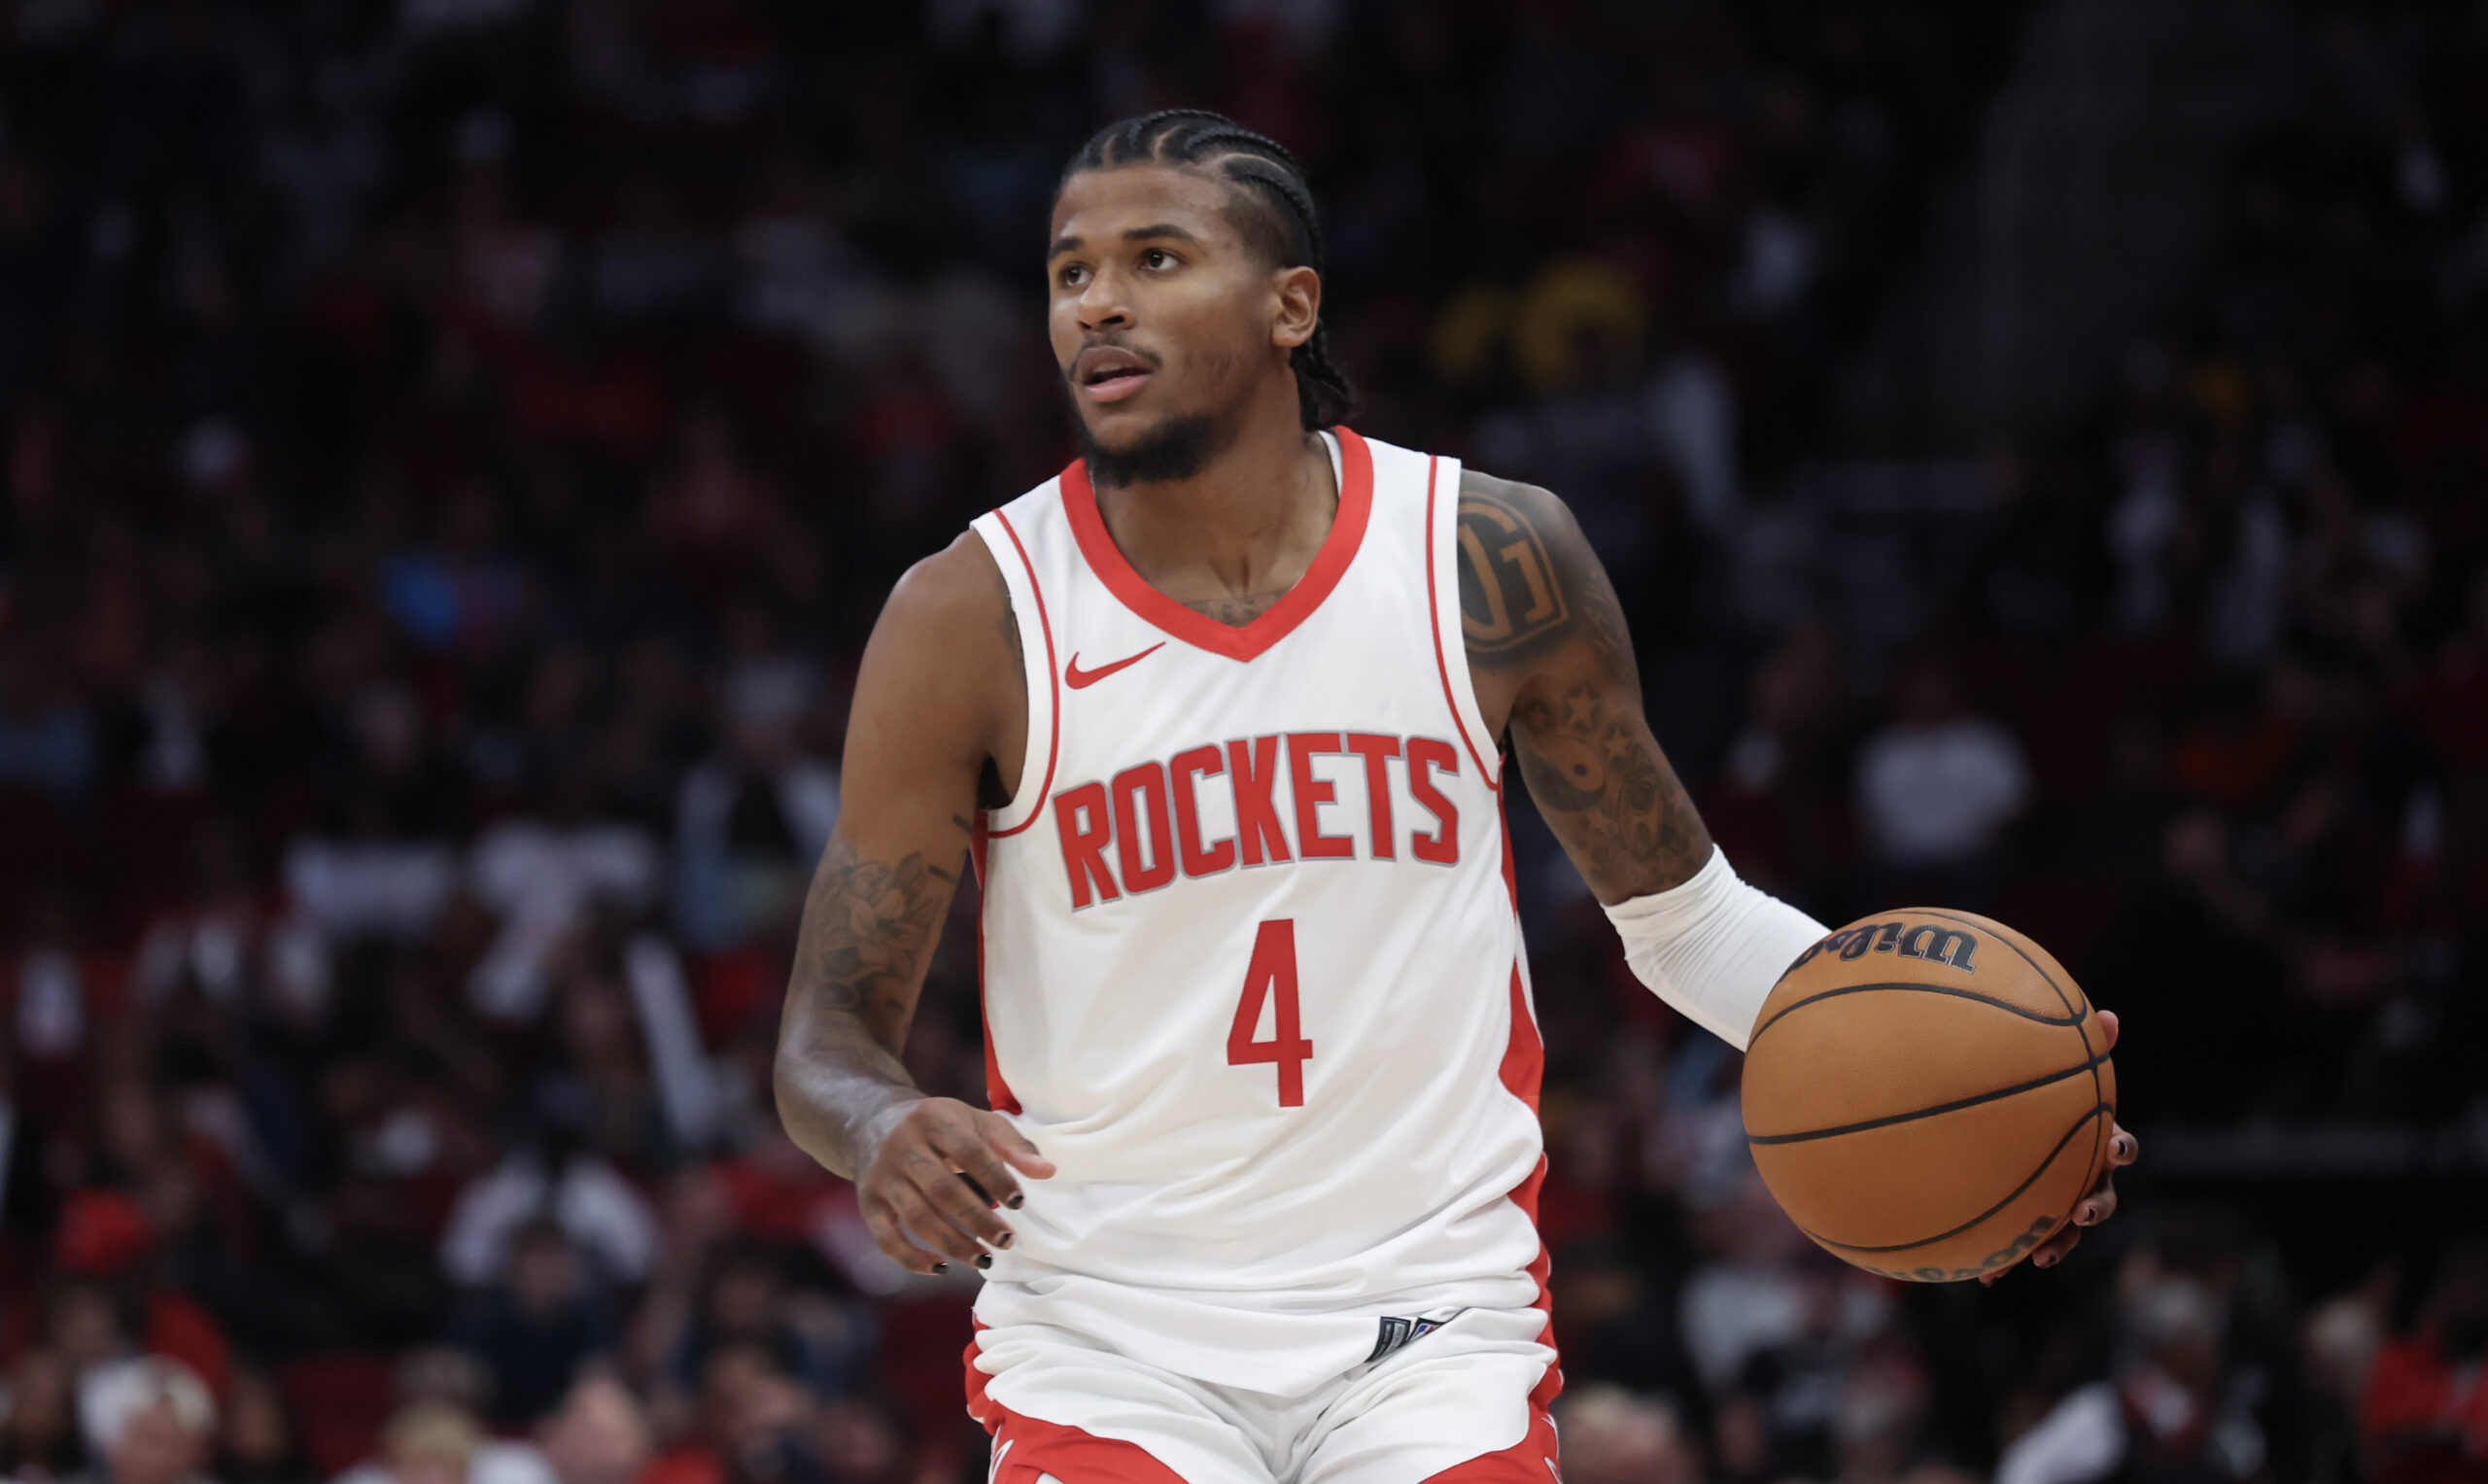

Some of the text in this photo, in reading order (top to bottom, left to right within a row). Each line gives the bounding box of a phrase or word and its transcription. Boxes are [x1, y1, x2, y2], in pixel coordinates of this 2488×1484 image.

[1051, 730, 1460, 913] ROCKETS
[1227, 917, 1313, 1107] 4
[1777, 922, 1977, 983] Wilso
